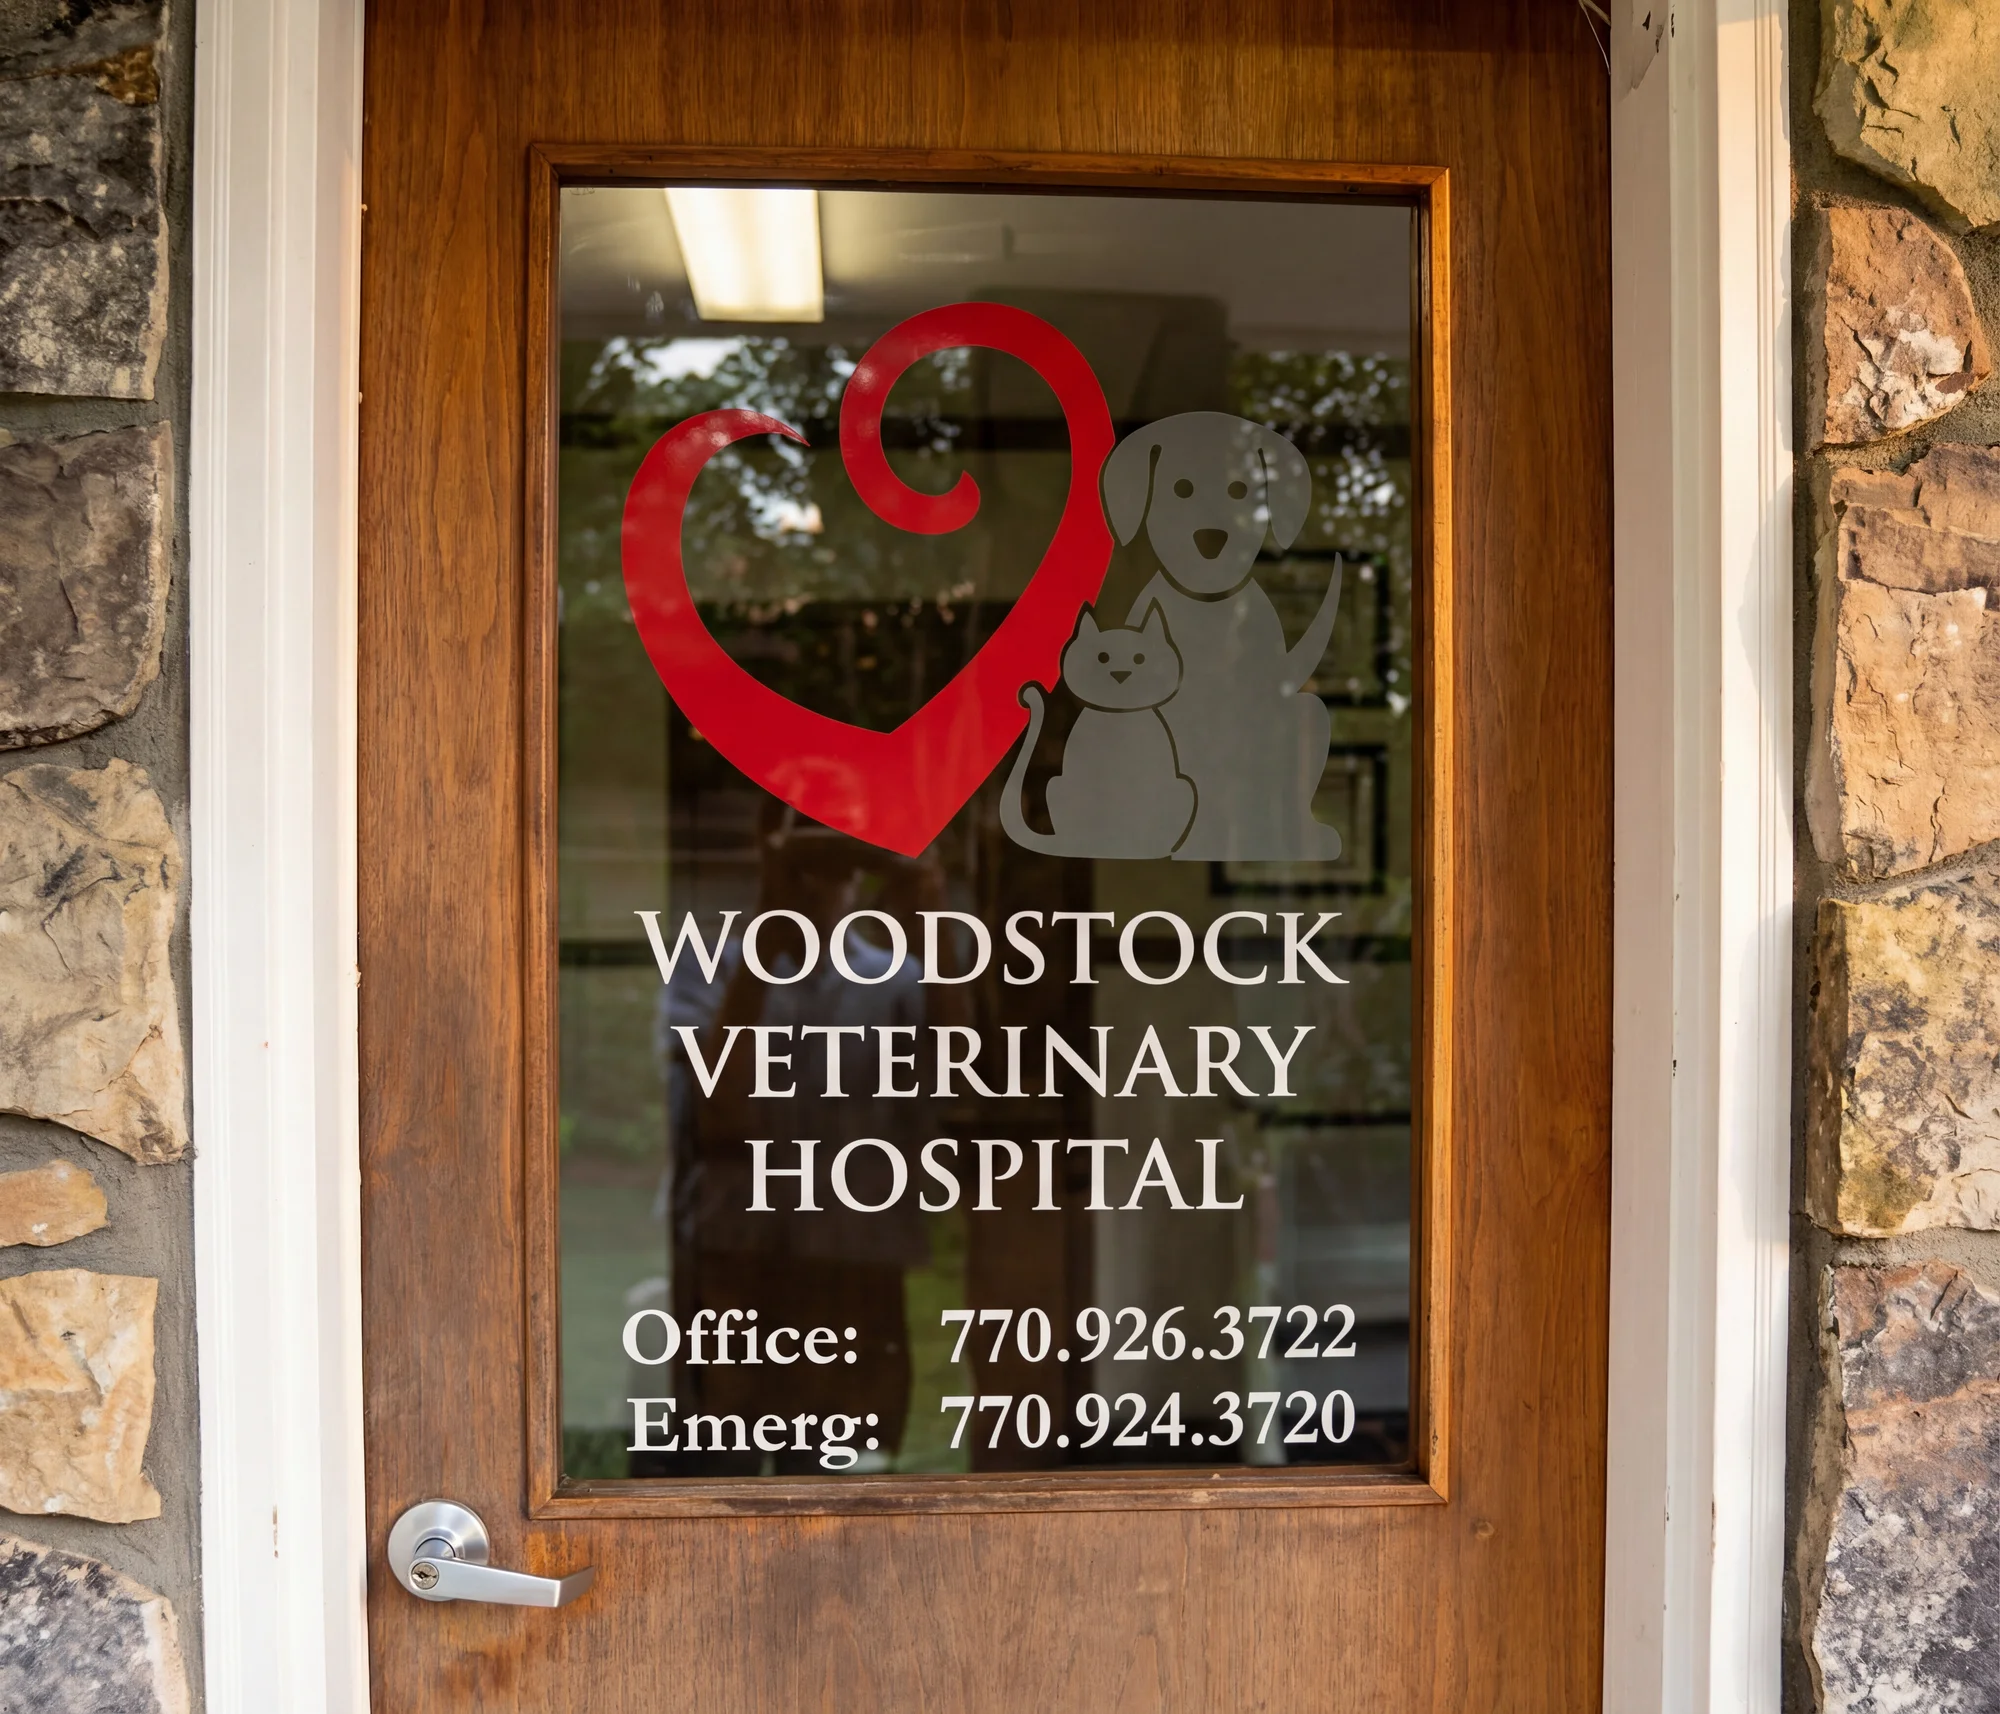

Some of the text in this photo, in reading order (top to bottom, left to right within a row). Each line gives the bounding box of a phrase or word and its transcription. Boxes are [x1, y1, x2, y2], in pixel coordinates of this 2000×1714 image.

[634, 909, 1350, 986] WOODSTOCK
[670, 1024, 1316, 1098] VETERINARY
[744, 1137, 1244, 1213] HOSPITAL
[622, 1303, 1357, 1366] Office: 770.926.3722
[626, 1389, 1355, 1470] Emerg: 770.924.3720
